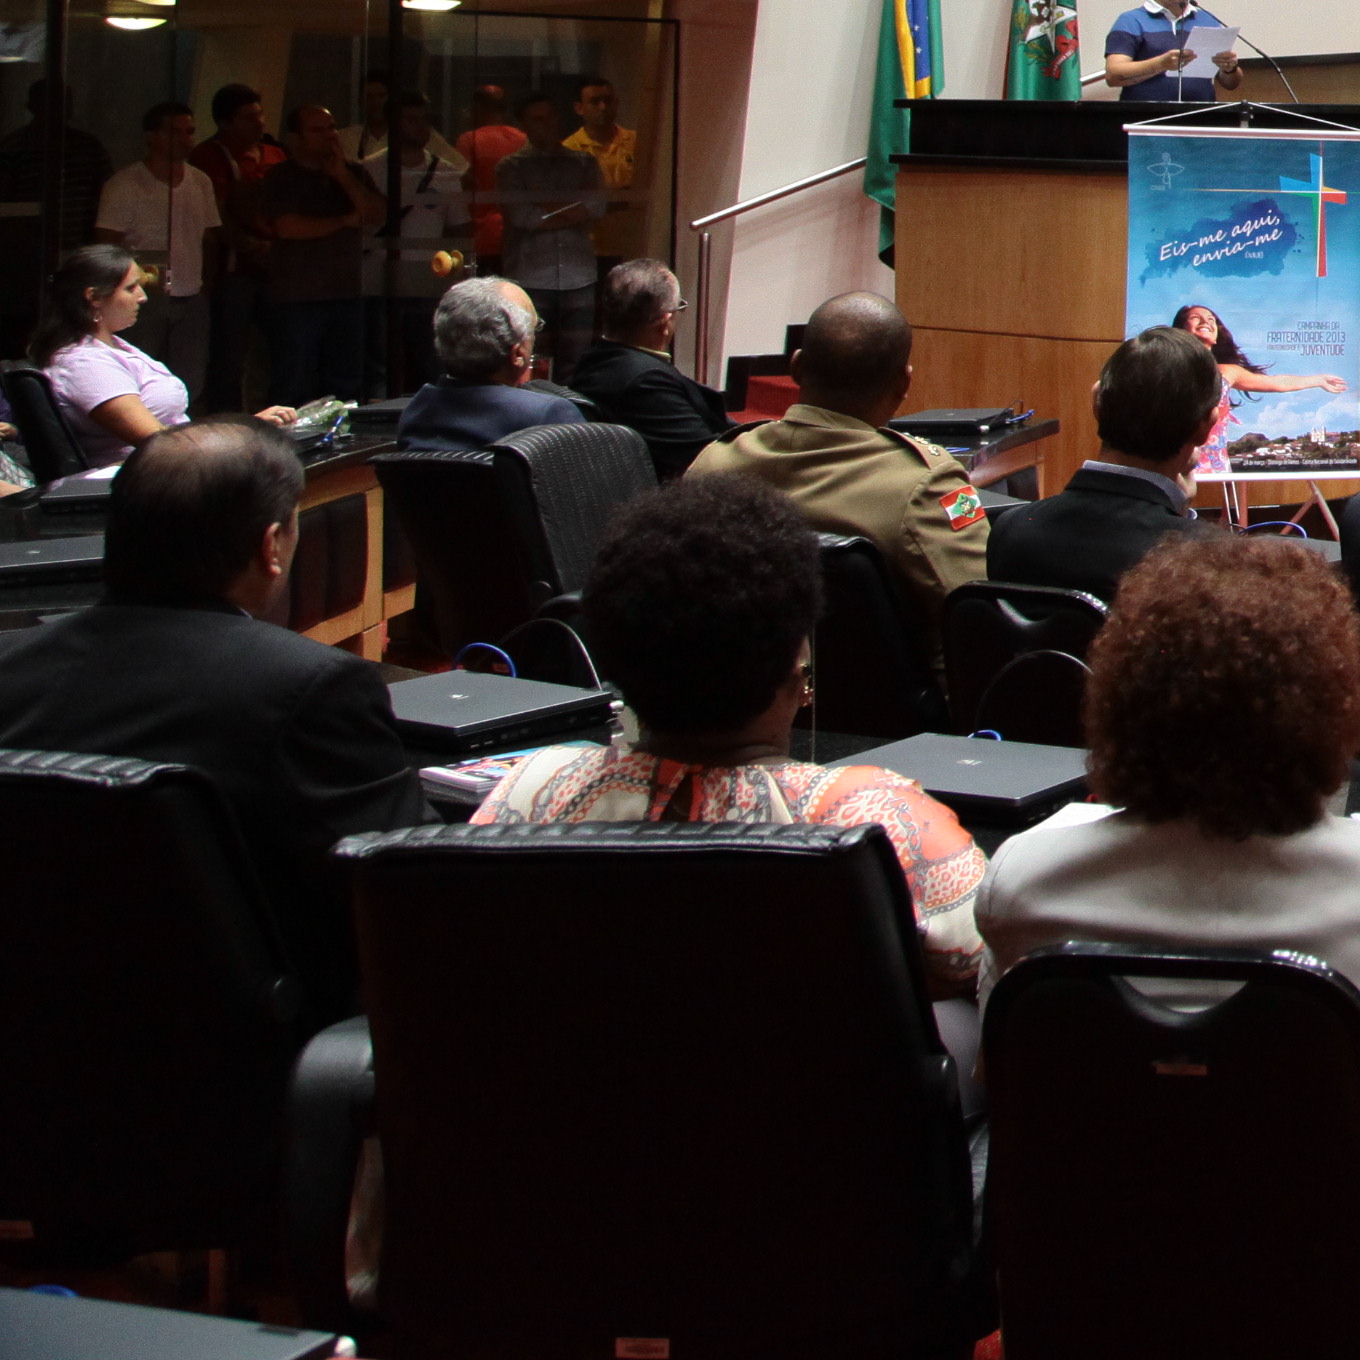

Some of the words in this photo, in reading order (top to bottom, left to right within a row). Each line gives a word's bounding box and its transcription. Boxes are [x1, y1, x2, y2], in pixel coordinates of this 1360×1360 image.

[1160, 229, 1228, 262] Eis-me
[1231, 209, 1281, 238] aqui,
[1192, 228, 1284, 267] envia-me
[1266, 331, 1324, 343] FRATERNIDADE
[1325, 331, 1346, 343] 2013
[1300, 344, 1345, 356] JUVENTUDE
